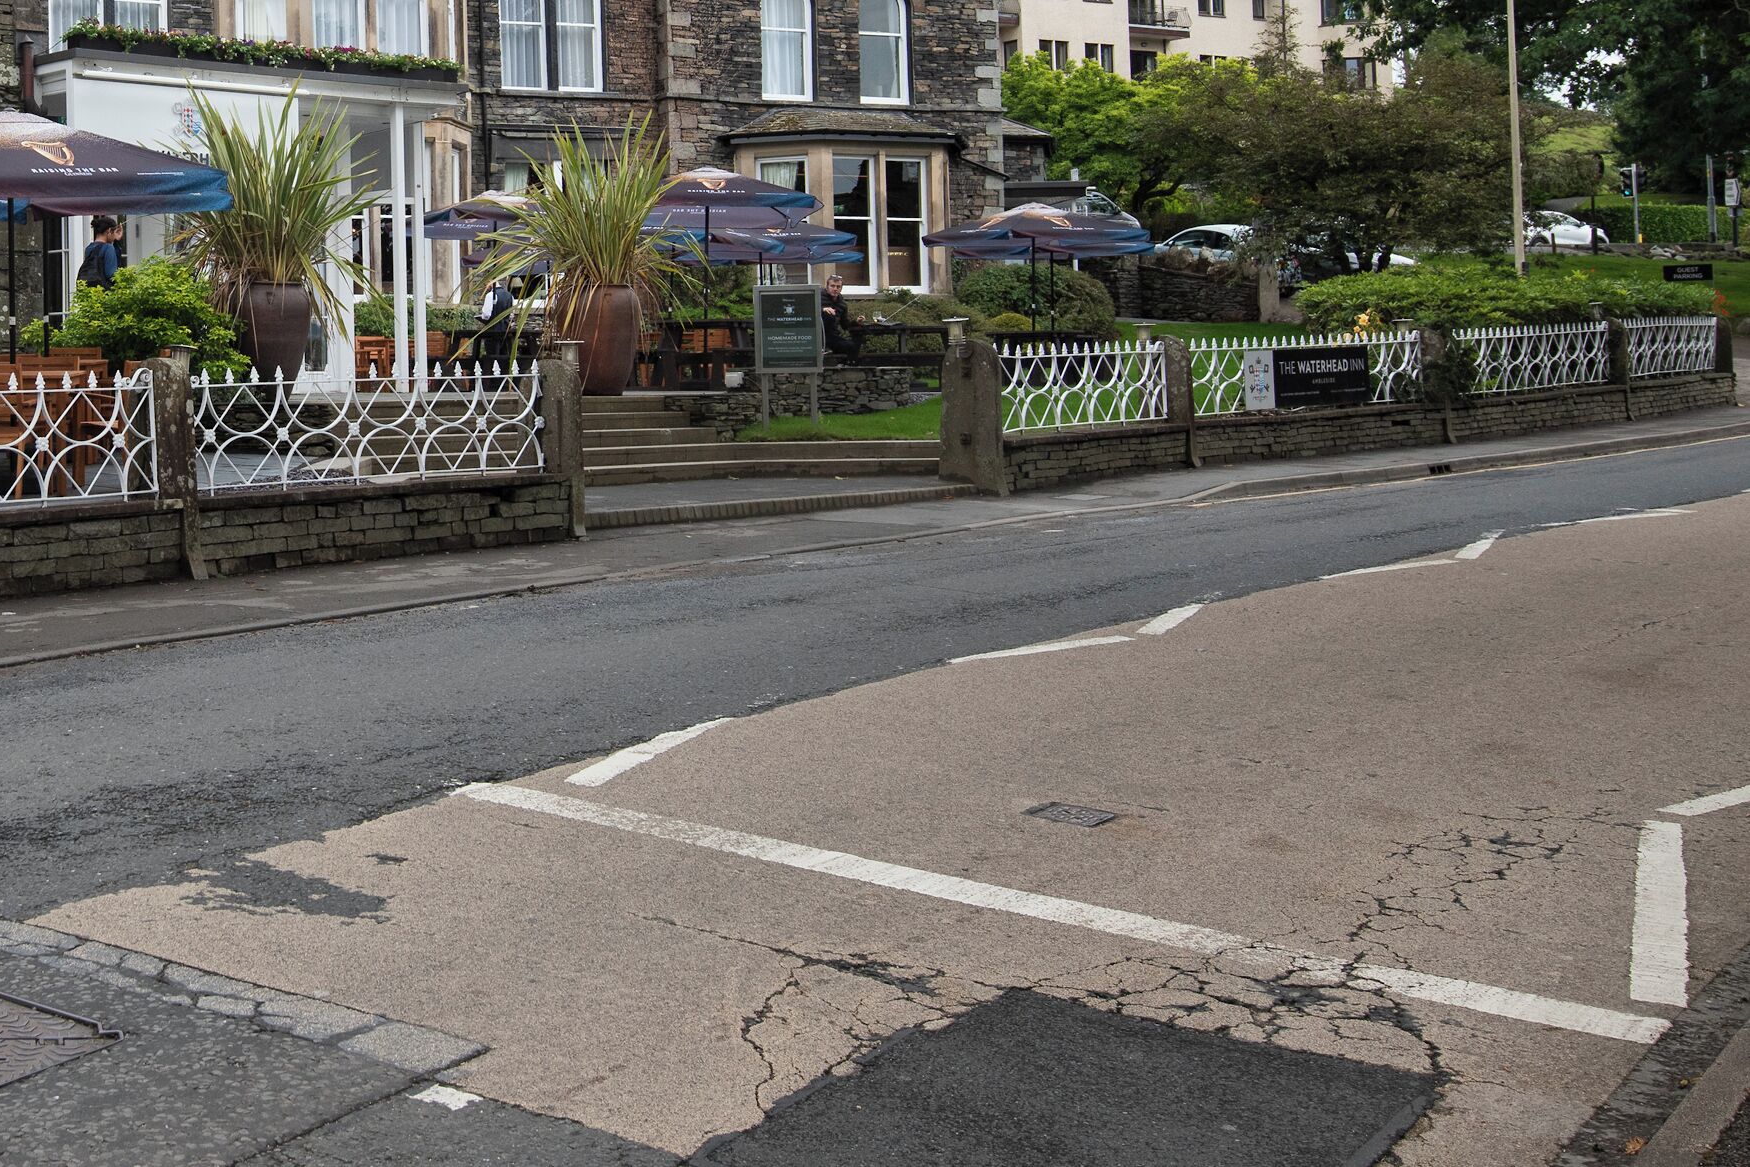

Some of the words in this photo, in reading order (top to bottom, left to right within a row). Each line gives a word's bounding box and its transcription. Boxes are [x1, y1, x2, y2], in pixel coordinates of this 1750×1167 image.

[1279, 361, 1296, 375] THE
[1297, 358, 1349, 374] WATERHEAD
[1349, 358, 1365, 371] INN
